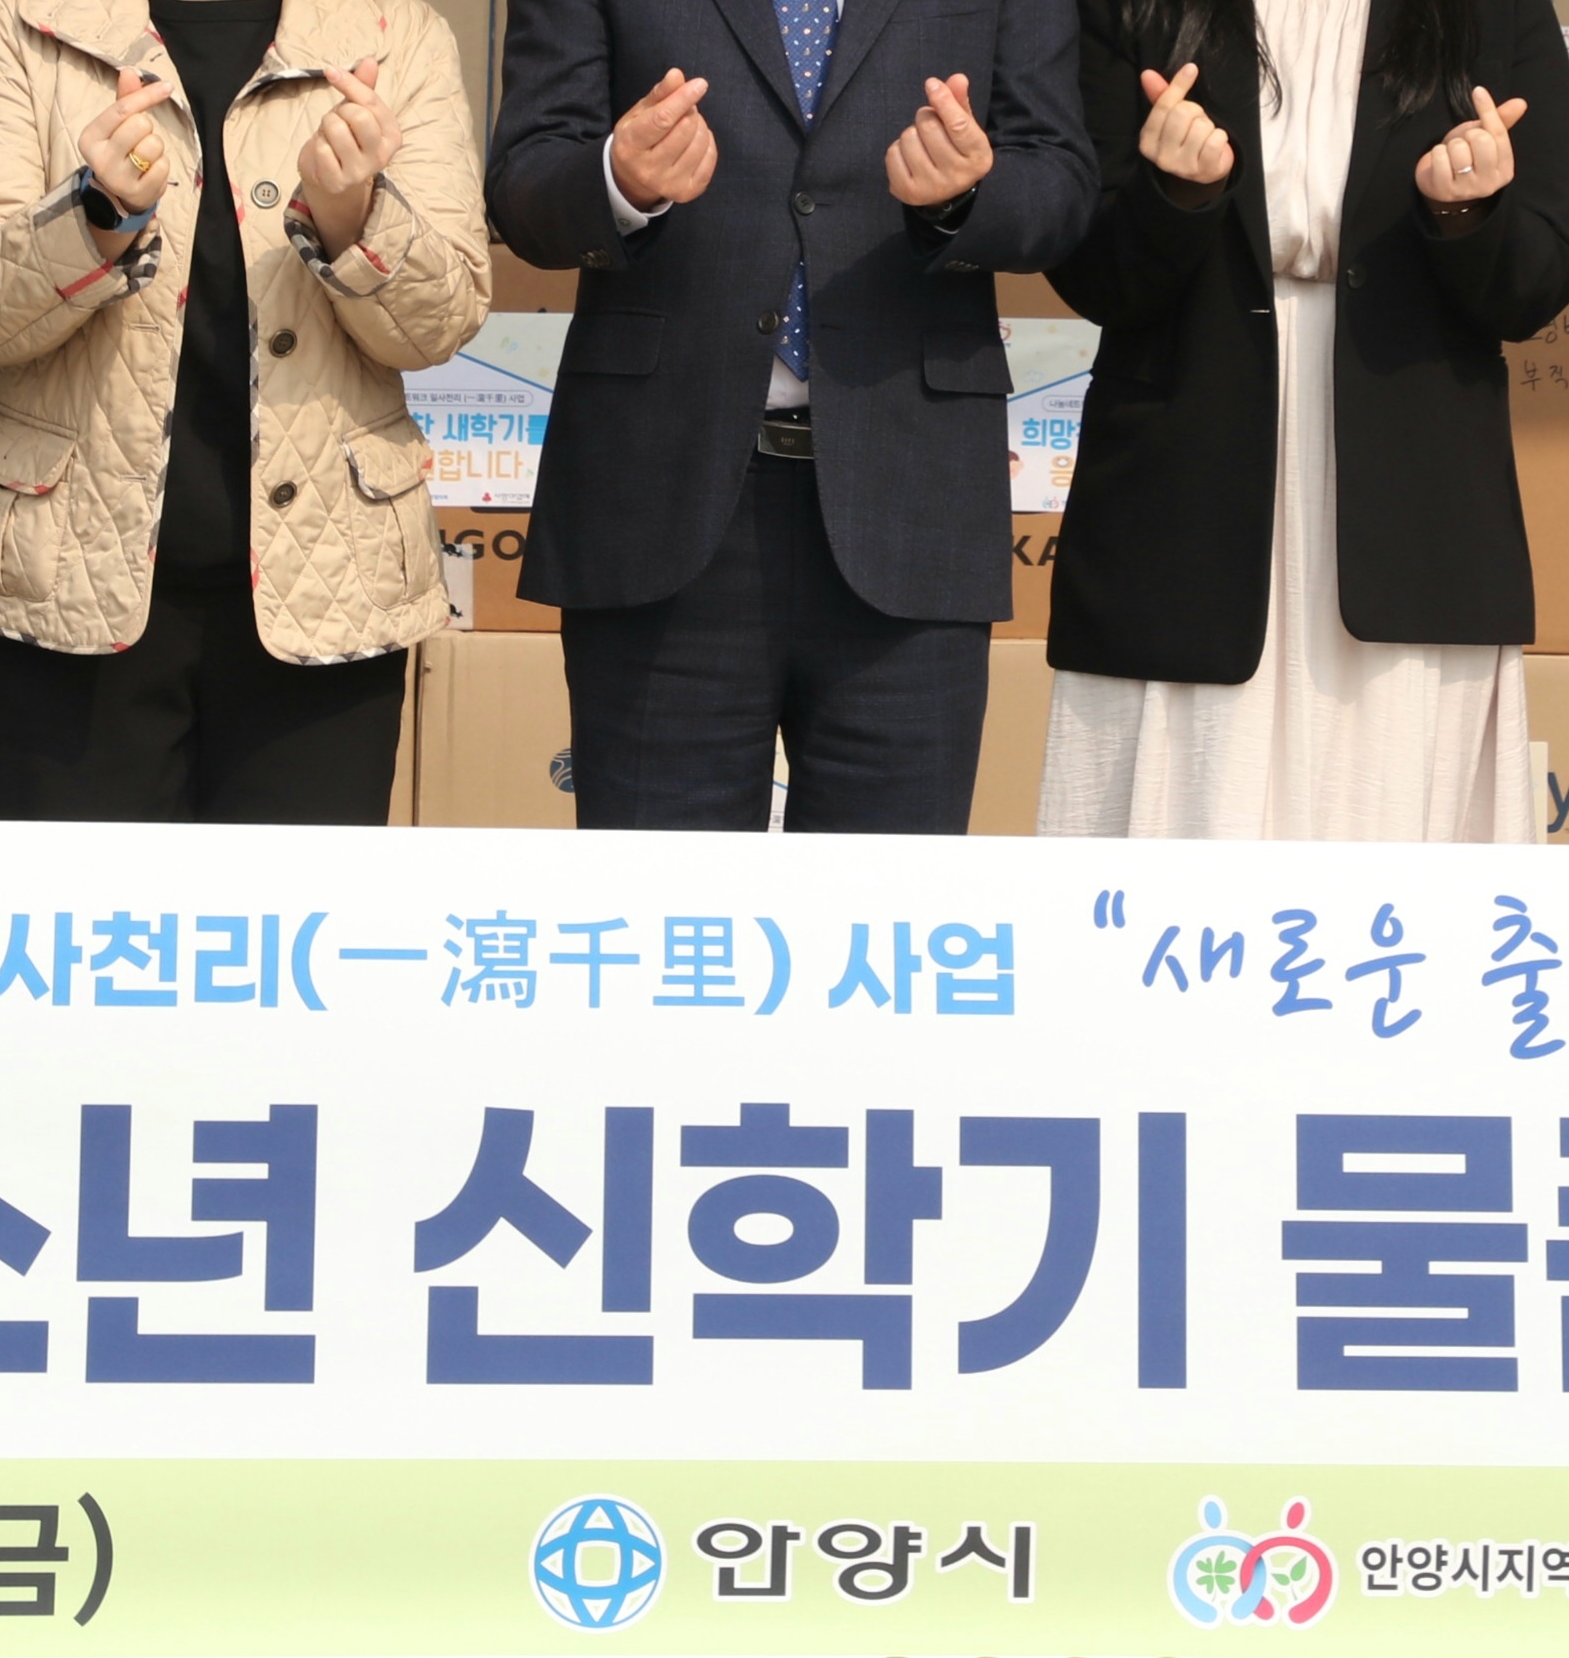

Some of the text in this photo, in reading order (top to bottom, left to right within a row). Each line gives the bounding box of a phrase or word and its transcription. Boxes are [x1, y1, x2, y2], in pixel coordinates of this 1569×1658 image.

[442, 413, 549, 446] 새학기를
[1021, 418, 1077, 451] 희망
[829, 921, 1015, 1015] 사업
[415, 1104, 1186, 1388] 신학기
[696, 1523, 1030, 1601] 안양시
